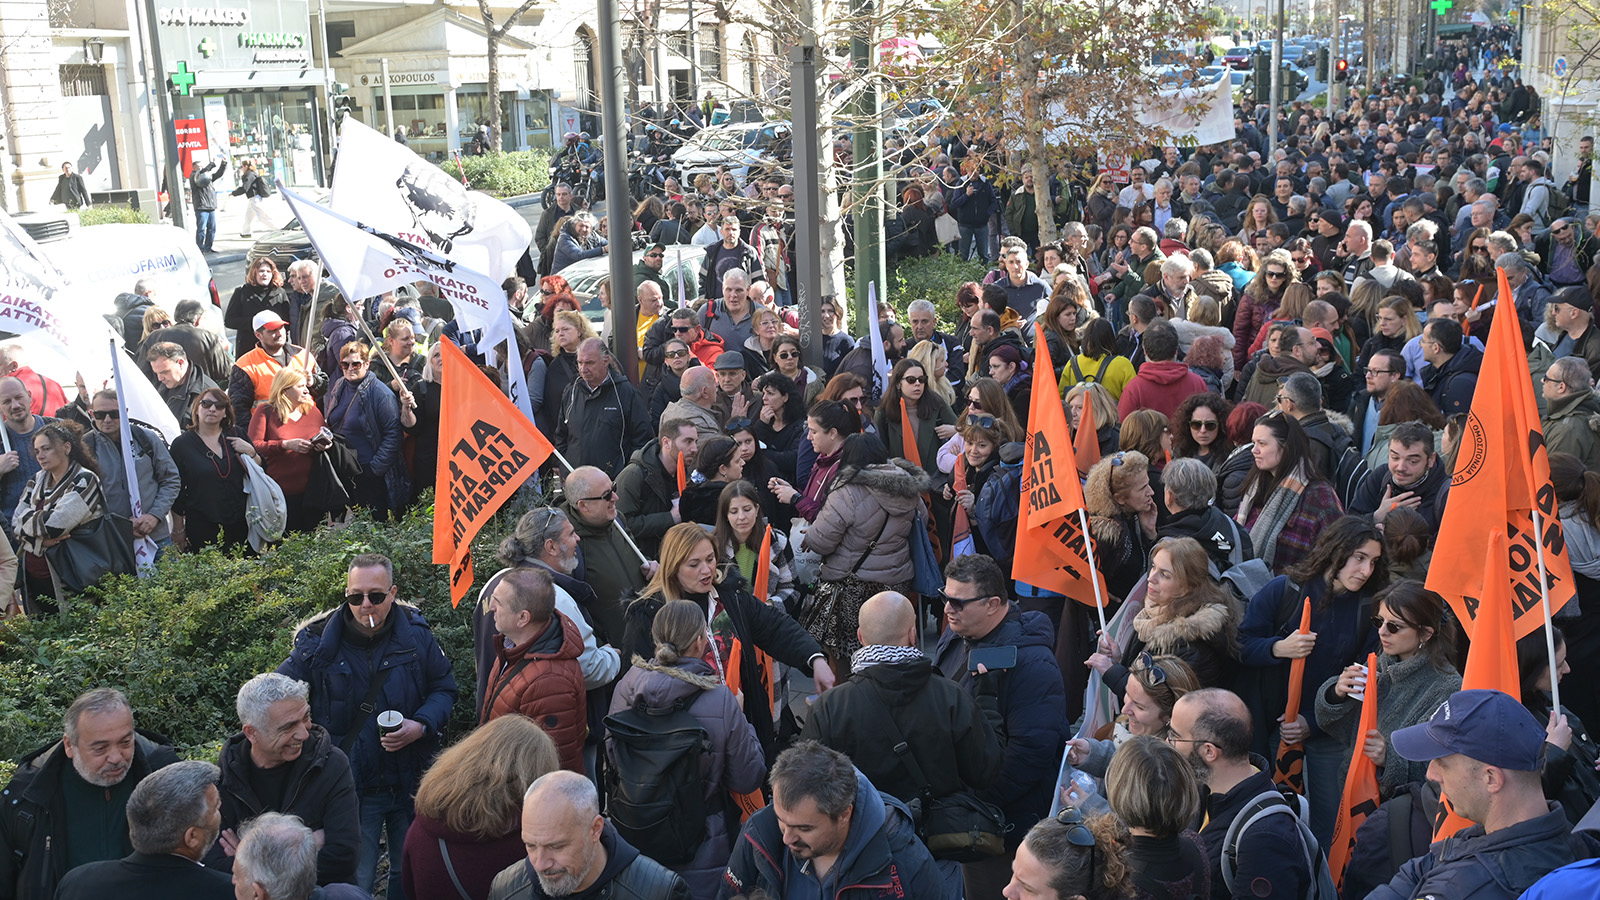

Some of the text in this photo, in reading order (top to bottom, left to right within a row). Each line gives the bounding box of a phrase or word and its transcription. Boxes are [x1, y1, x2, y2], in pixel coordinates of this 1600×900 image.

[241, 32, 307, 47] PHARMACY
[0, 293, 63, 328] ΔΙΚΑΤΟ
[1466, 424, 1484, 475] ΟΜΟΣΠΟΝΔΙΑ
[890, 864, 905, 899] SUPER
